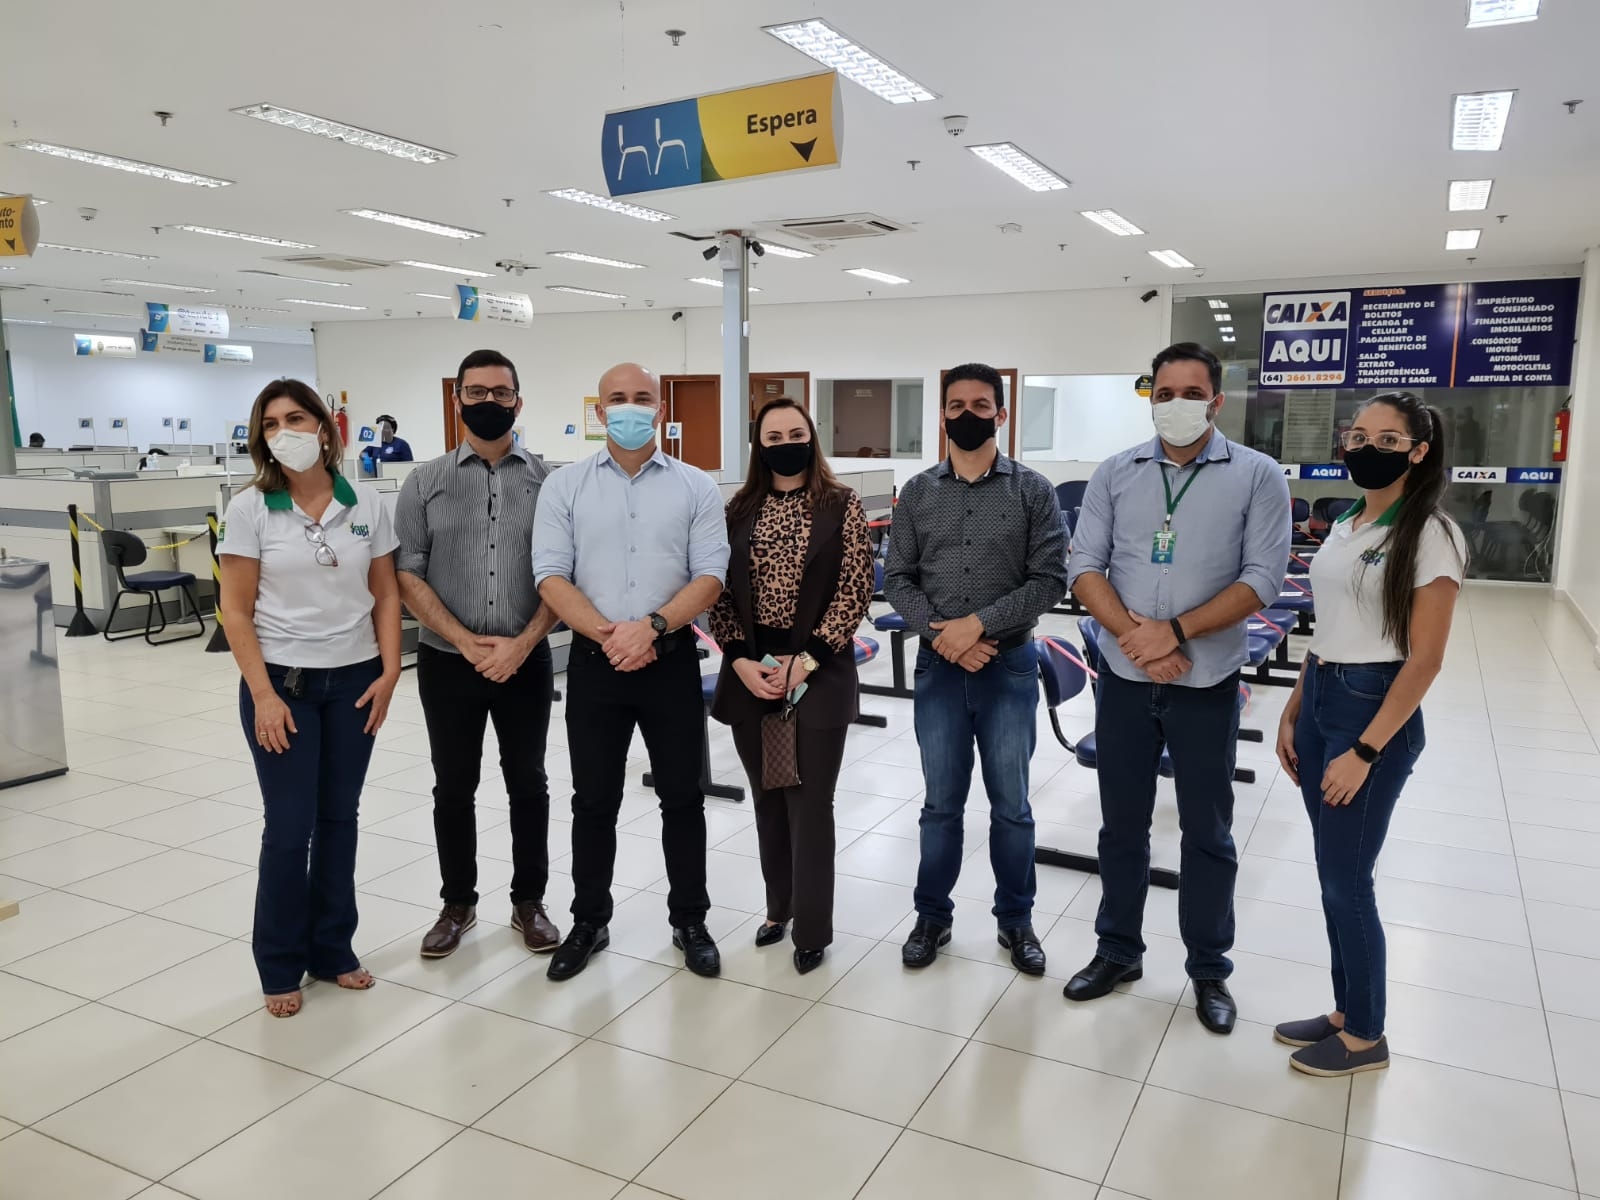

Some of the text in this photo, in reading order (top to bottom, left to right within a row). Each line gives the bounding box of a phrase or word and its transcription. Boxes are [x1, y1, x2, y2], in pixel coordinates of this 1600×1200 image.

[747, 108, 807, 136] Espera
[1476, 296, 1535, 305] EMPRÉSTIMO
[1362, 302, 1421, 311] RECEBIMENTO
[1492, 304, 1555, 313] CONSIGNADO
[1266, 301, 1347, 324] CAIXA
[1364, 311, 1402, 319] BOLETOS
[1361, 318, 1414, 327] RECARGA DE
[1474, 316, 1553, 325] FINANCIAMENTOS
[1371, 327, 1408, 335] CELULAR
[1490, 324, 1553, 333] IMOBILIÁRIOS
[1360, 335, 1413, 344] PAGAMENTO
[1471, 336, 1522, 345] CONSÓRCIOS
[1268, 338, 1341, 363] AQUI
[1489, 353, 1540, 362] AUTOMÓVEIS
[1358, 367, 1430, 376] TRANSFERÊNCIAS
[1493, 363, 1551, 371] MOTOCICLETAS
[1263, 374, 1342, 384] (64) 3661.8294
[1357, 376, 1399, 384] DEPÓSITO
[1512, 374, 1523, 382] DE
[363, 430, 373, 439] 02
[1312, 468, 1341, 477] AQUI
[1457, 471, 1554, 480] CAIXA AQUI
